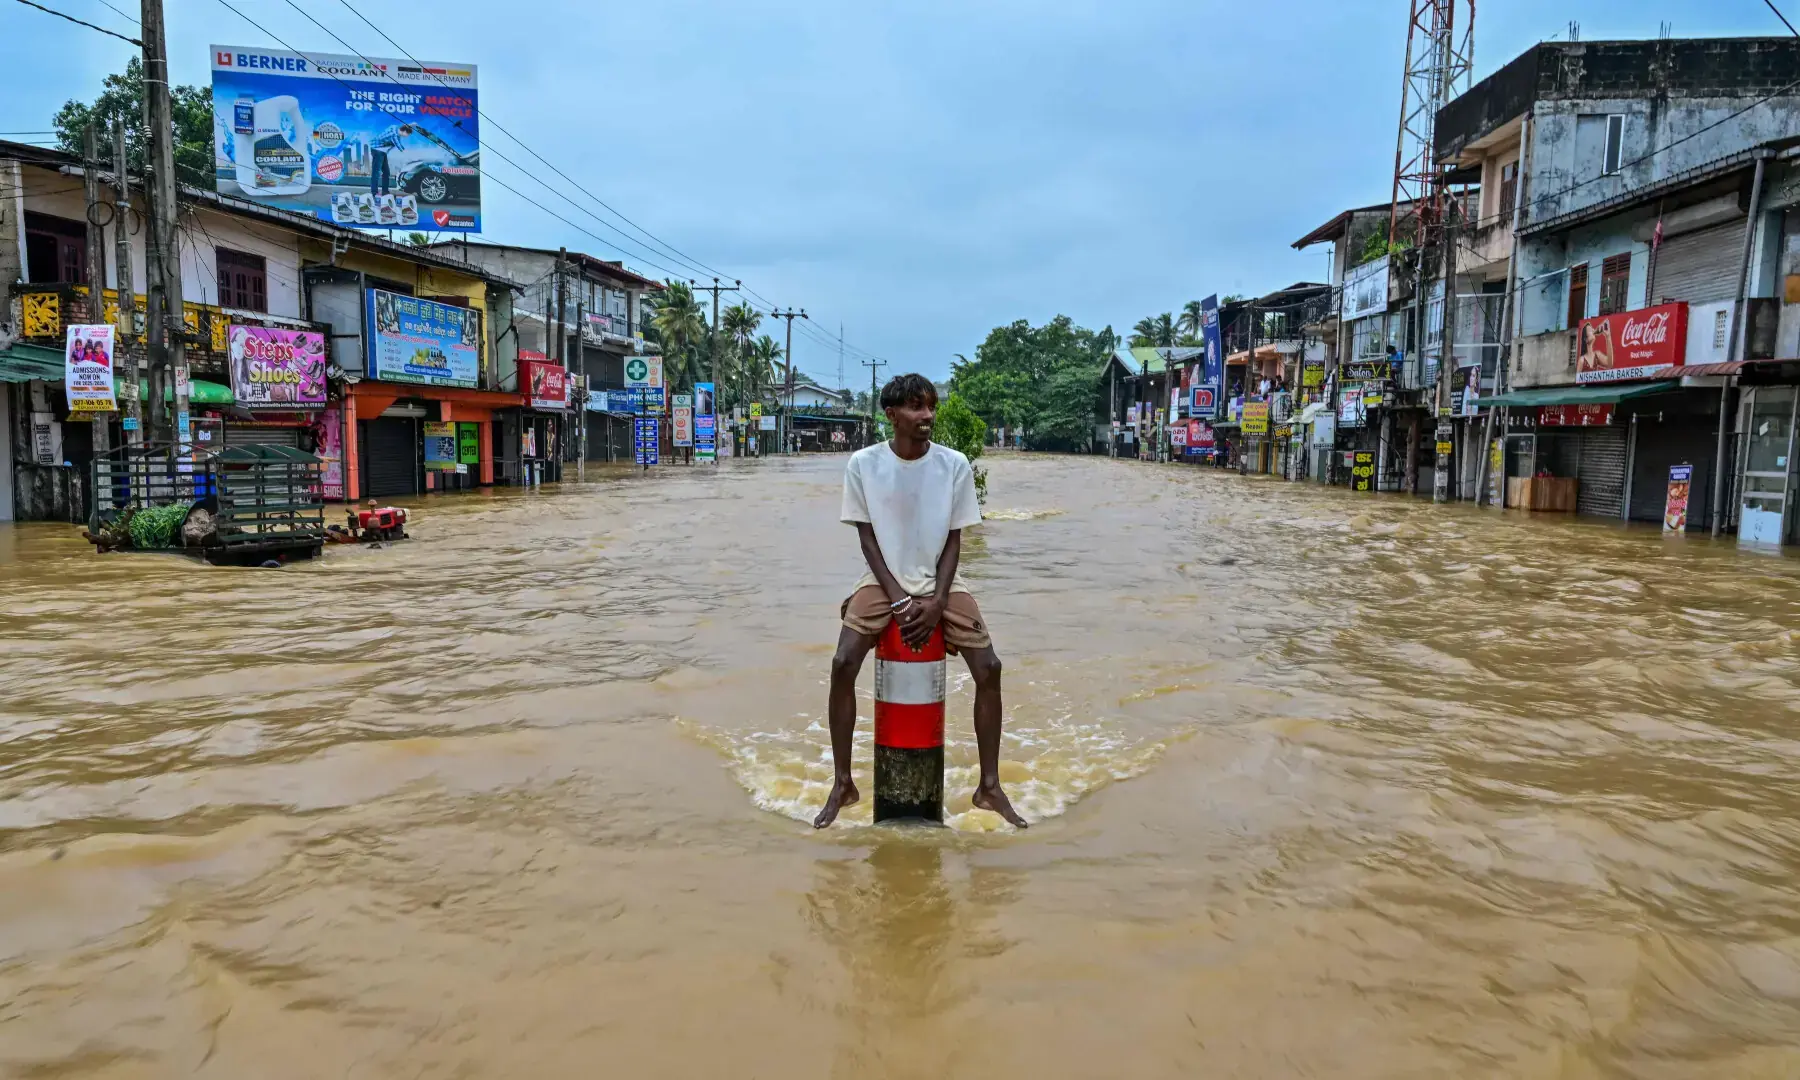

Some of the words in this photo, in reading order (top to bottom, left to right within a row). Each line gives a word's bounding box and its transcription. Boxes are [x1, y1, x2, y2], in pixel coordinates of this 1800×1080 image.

[236, 53, 307, 72] BERNER
[316, 60, 355, 68] RADIATOR
[316, 66, 386, 78] COOLANT
[397, 72, 420, 80] MADE
[430, 75, 471, 84] GERMANY
[350, 90, 375, 100] THE
[379, 92, 421, 104] RIGHT
[425, 95, 472, 106] MATCH
[345, 101, 372, 111] FOR
[377, 103, 415, 114] YOUR
[418, 105, 472, 118] VEHICLE
[318, 163, 342, 173] ORIGINAL
[442, 167, 475, 175] Solution
[1621, 311, 1670, 348] Coca-Cola
[244, 335, 294, 365] Steps
[1630, 351, 1640, 359] Real
[1640, 350, 1655, 359] Magic
[72, 366, 106, 374] ADMISSIONS
[249, 361, 301, 383] Shoes
[1347, 366, 1373, 378] Salon
[1369, 362, 1384, 379] V
[1579, 370, 1615, 381] NISHANTHA
[1617, 367, 1643, 378] BAKERS
[460, 430, 477, 440] BETTING
[461, 445, 477, 456] CENTER
[323, 485, 343, 498] SHOES
